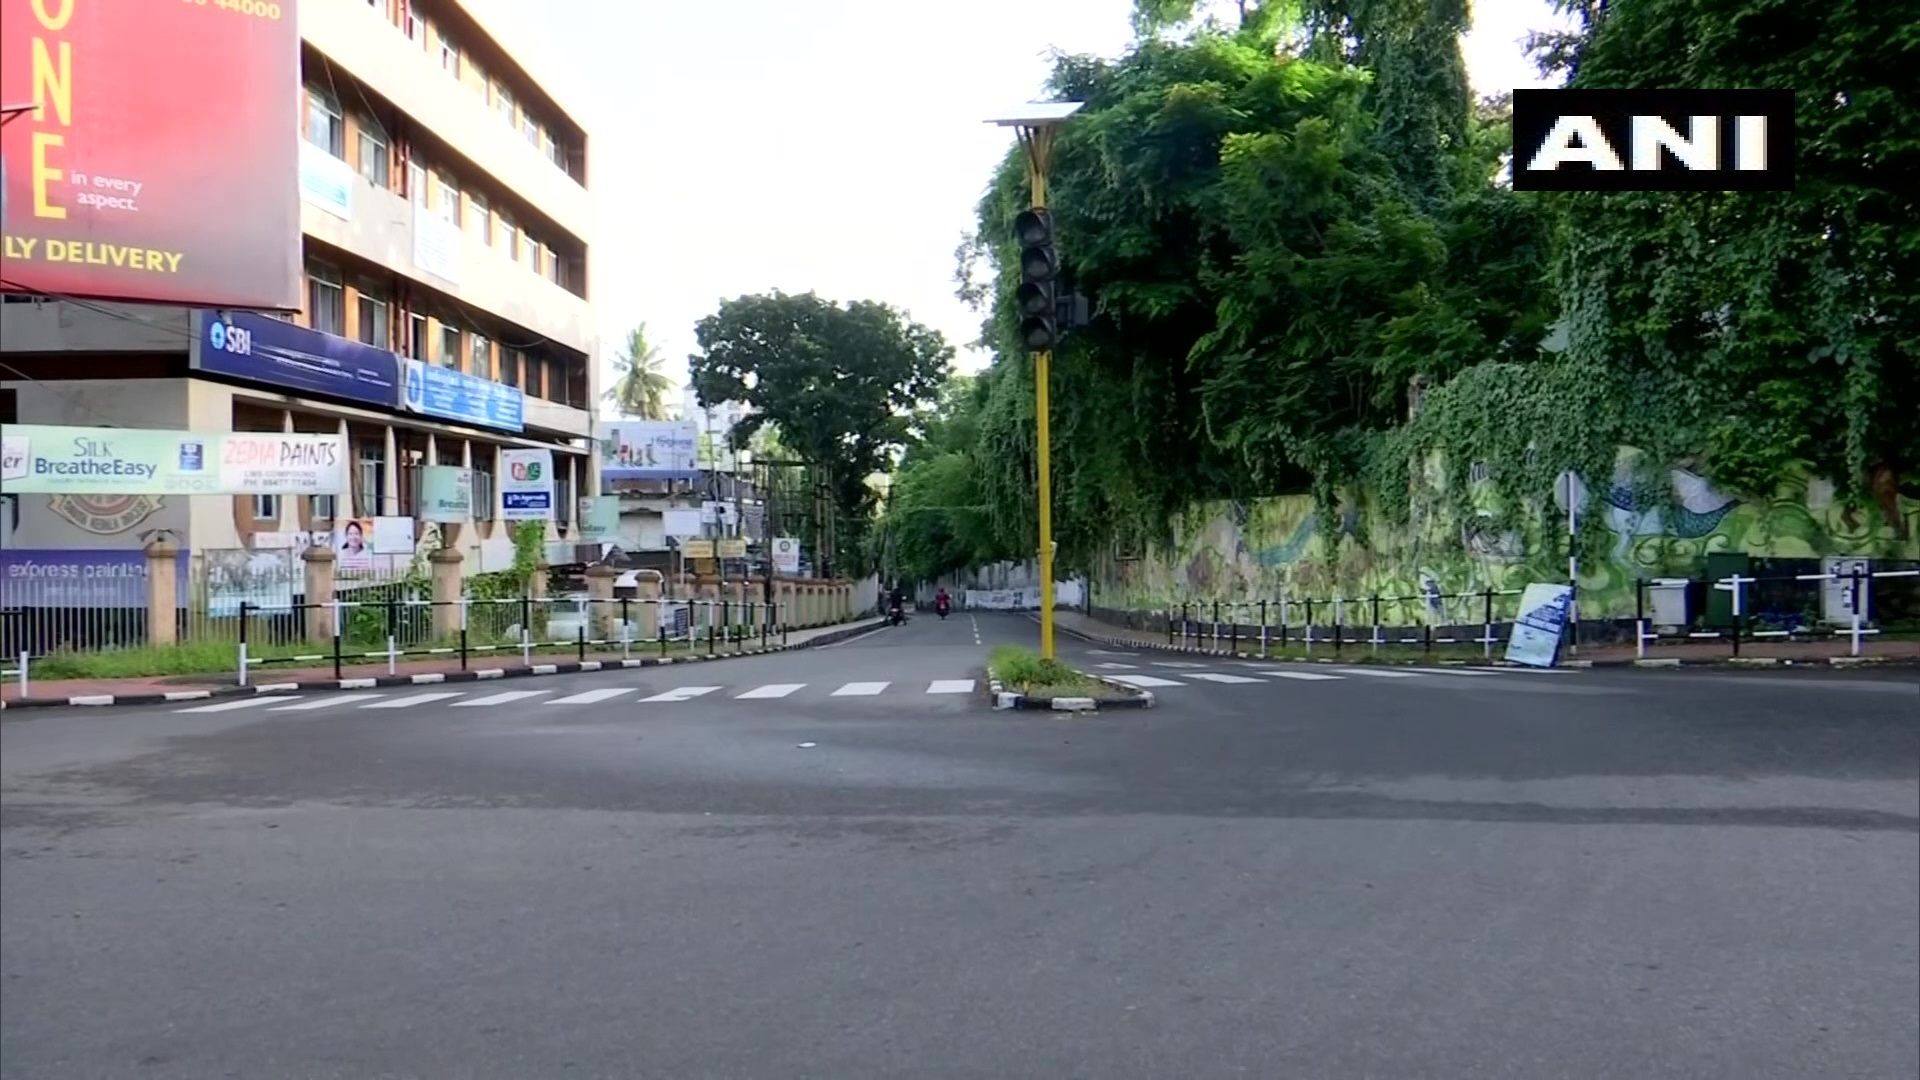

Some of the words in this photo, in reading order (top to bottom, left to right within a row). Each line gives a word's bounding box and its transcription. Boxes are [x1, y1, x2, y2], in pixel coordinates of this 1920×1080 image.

[71, 170, 87, 185] in
[94, 173, 142, 196] every
[77, 191, 139, 211] aspect.
[3, 236, 37, 259] LY
[46, 240, 183, 272] DELIVERY
[226, 326, 250, 355] SBI
[279, 441, 336, 466] PAINTS
[35, 458, 157, 479] BreatheEasy
[9, 560, 79, 580] express
